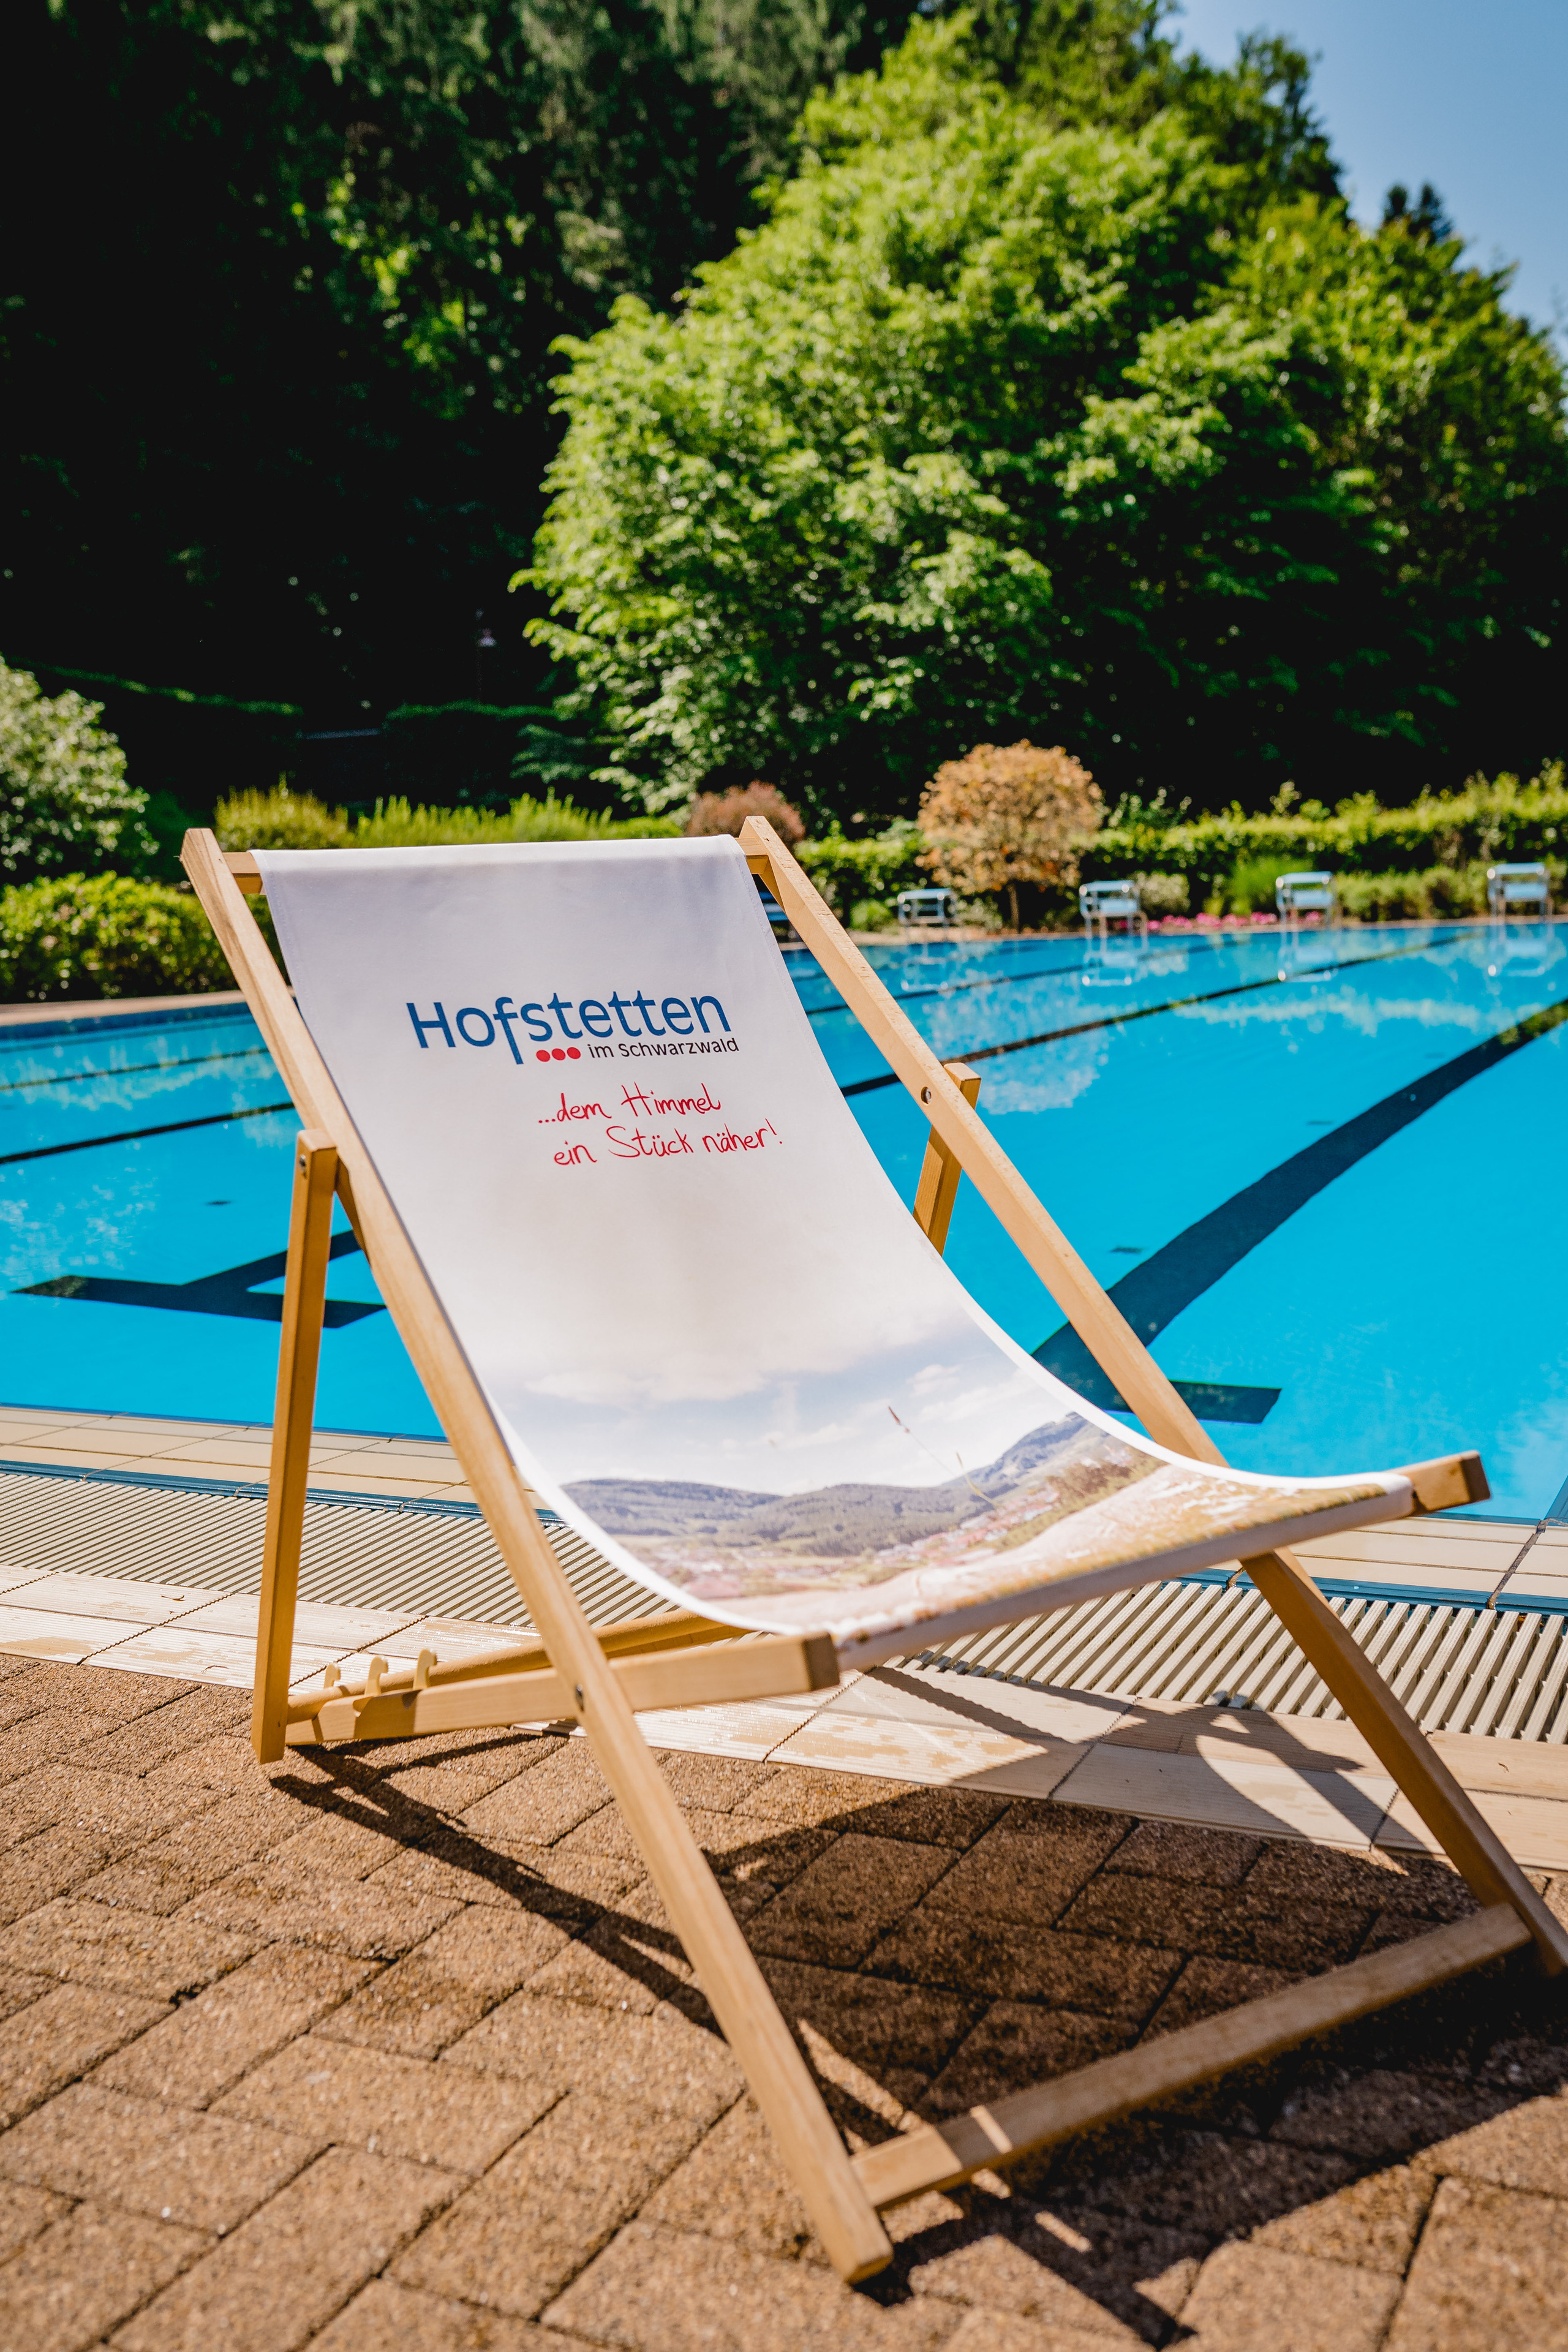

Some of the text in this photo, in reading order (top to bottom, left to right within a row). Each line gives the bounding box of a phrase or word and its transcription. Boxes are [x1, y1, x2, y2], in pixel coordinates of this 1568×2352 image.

[406, 990, 731, 1065] Hofstetten
[587, 1038, 739, 1058] im Schwarzwald
[621, 1082, 721, 1117] Himmel
[554, 1118, 782, 1166] ein Stück näher!
